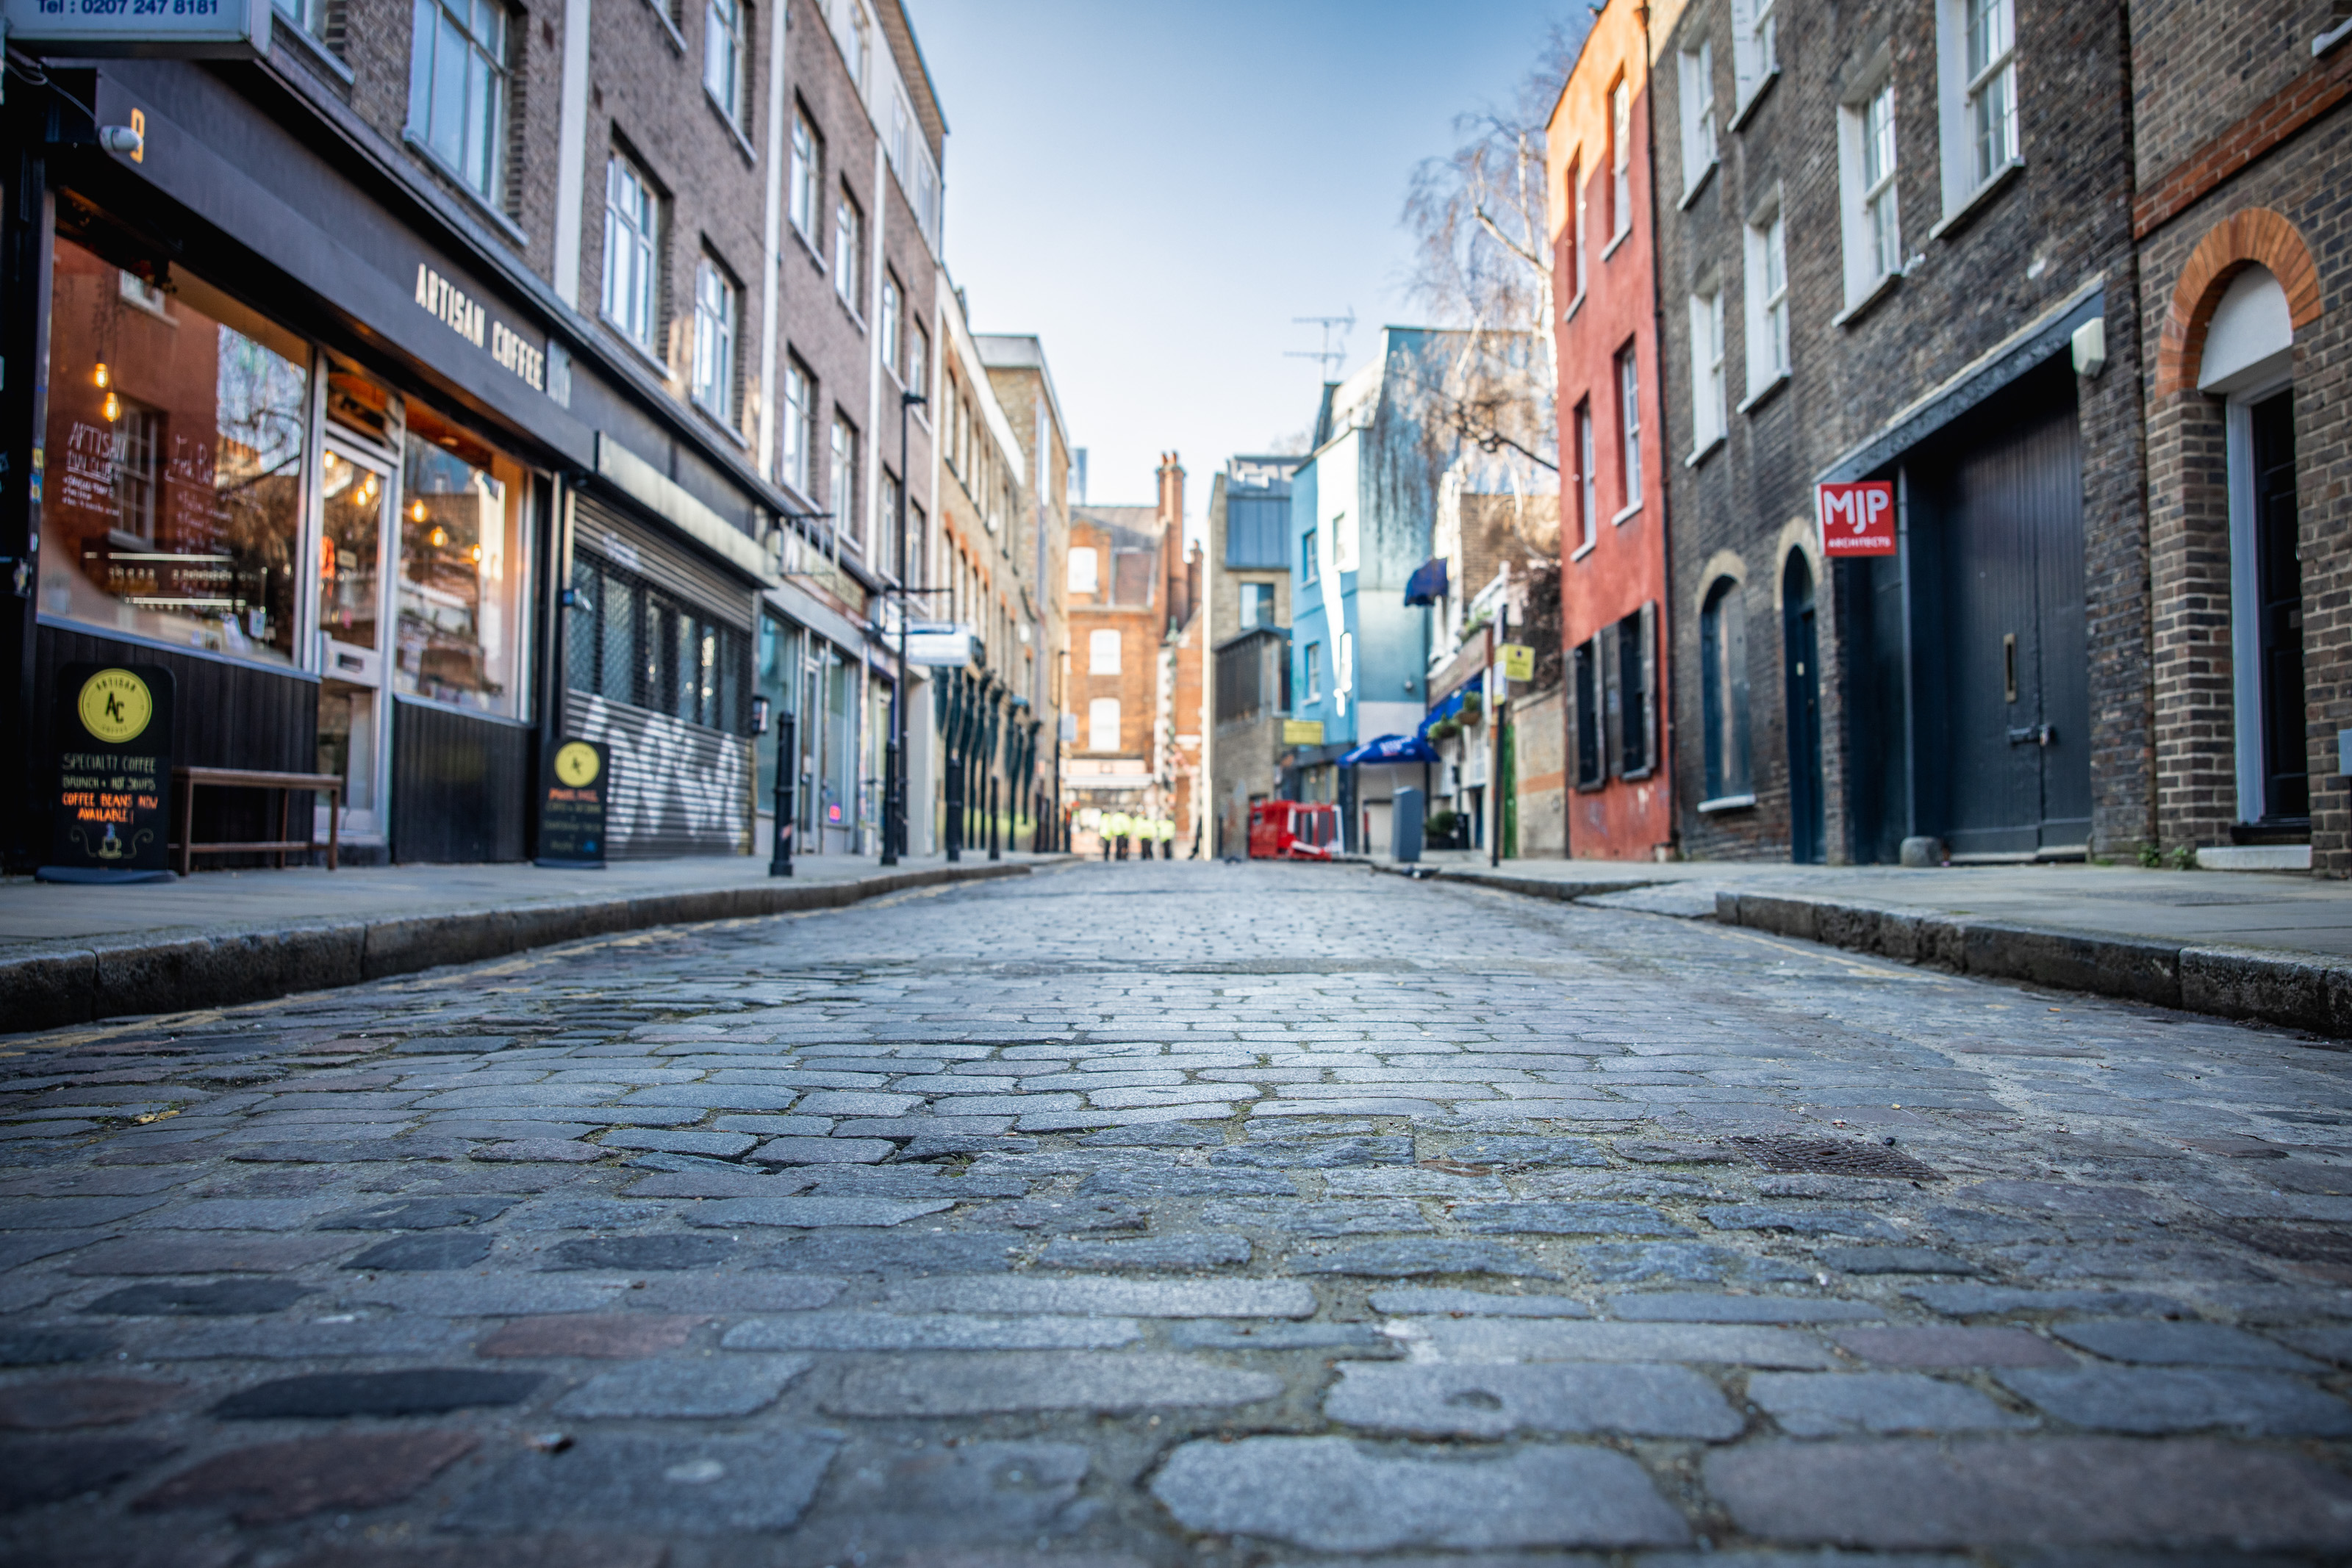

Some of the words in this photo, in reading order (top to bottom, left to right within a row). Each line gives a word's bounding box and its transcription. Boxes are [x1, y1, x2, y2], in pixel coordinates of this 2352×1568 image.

[39, 0, 63, 13] Tel
[81, 0, 127, 14] 0207
[132, 0, 168, 15] 247
[173, 0, 218, 15] 8181
[415, 262, 485, 348] ARTISAN
[492, 320, 544, 392] COFFEE
[1824, 489, 1889, 534] MJP
[1827, 536, 1892, 548] ARCHITECTS
[96, 676, 137, 693] ARTISAN
[62, 752, 118, 772] SPECIALTY
[121, 755, 157, 774] COFFEE
[62, 774, 100, 790] BRUNCH
[110, 776, 126, 791] HOT
[62, 791, 96, 807] COFFEE
[99, 792, 133, 808] BEANS
[137, 794, 159, 810] NOW
